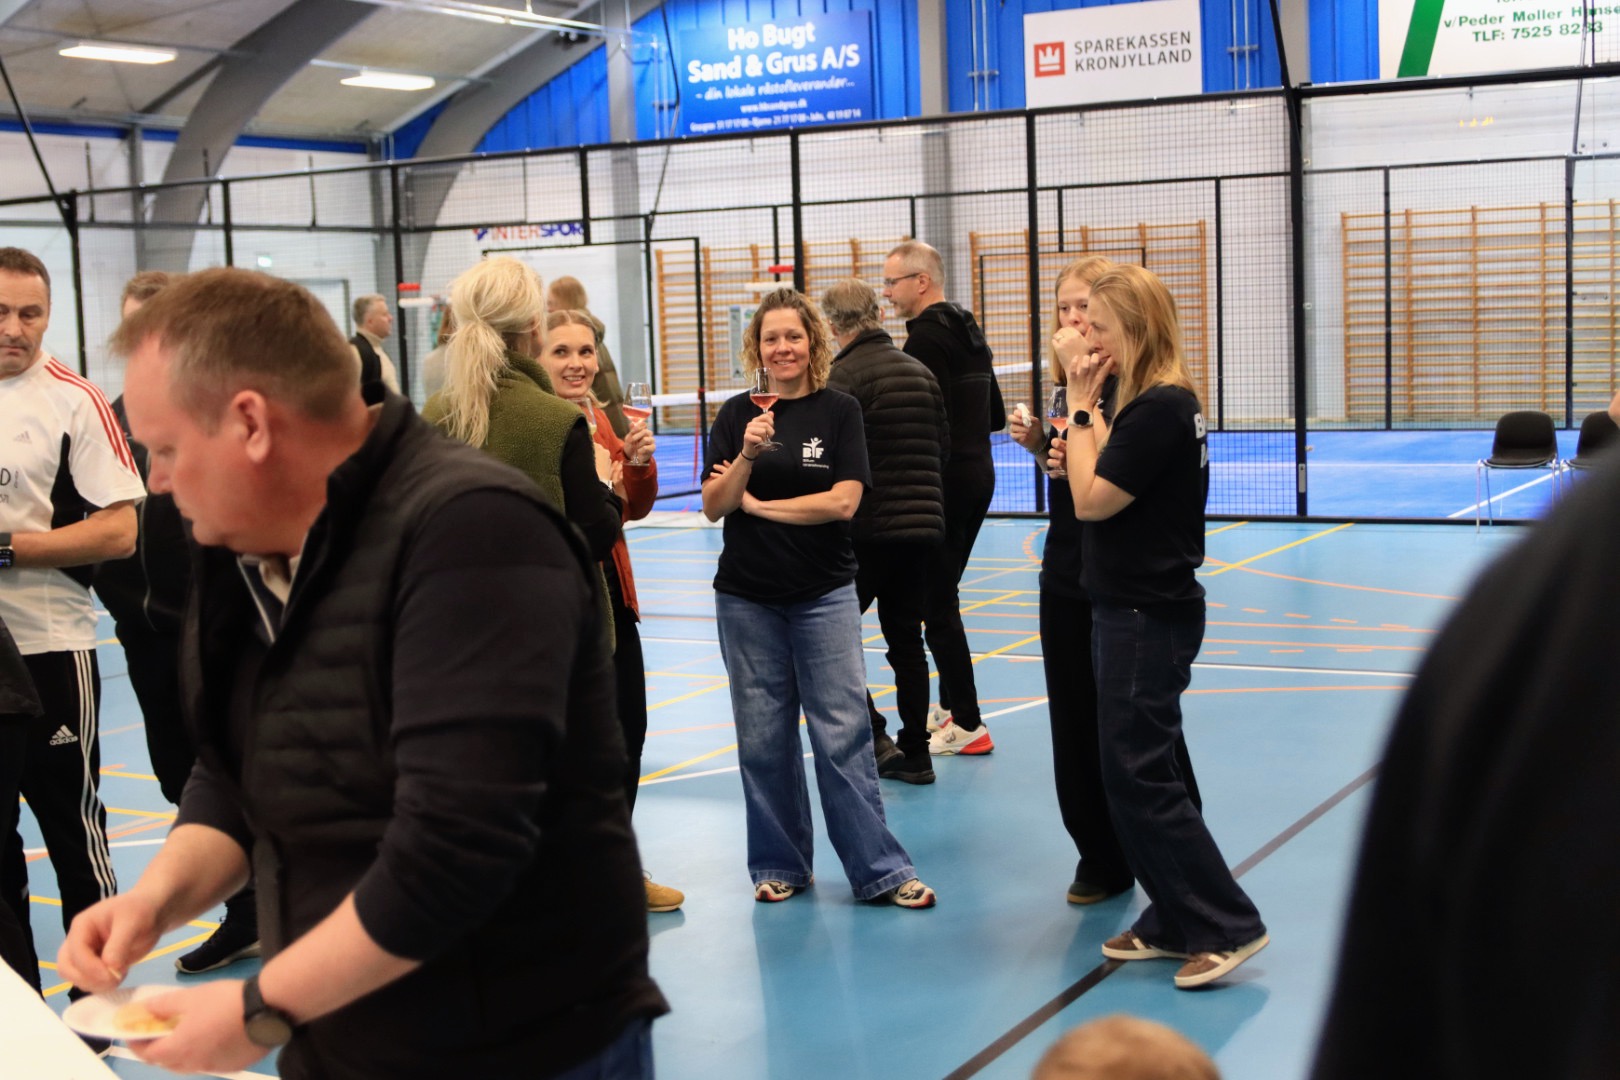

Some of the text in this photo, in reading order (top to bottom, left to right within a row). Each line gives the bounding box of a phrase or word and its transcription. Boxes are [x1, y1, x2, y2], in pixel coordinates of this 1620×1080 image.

[1444, 15, 1505, 28] v/Peder
[728, 22, 816, 50] Ho Bugt
[1074, 31, 1191, 55] SPAREKASSEN
[1472, 29, 1505, 42] TLF:
[1512, 26, 1552, 40] 7525
[687, 44, 860, 83] Sand & Grus A/S
[1075, 48, 1192, 72] KRONJYLLAND
[491, 221, 584, 240] INTERSPOR
